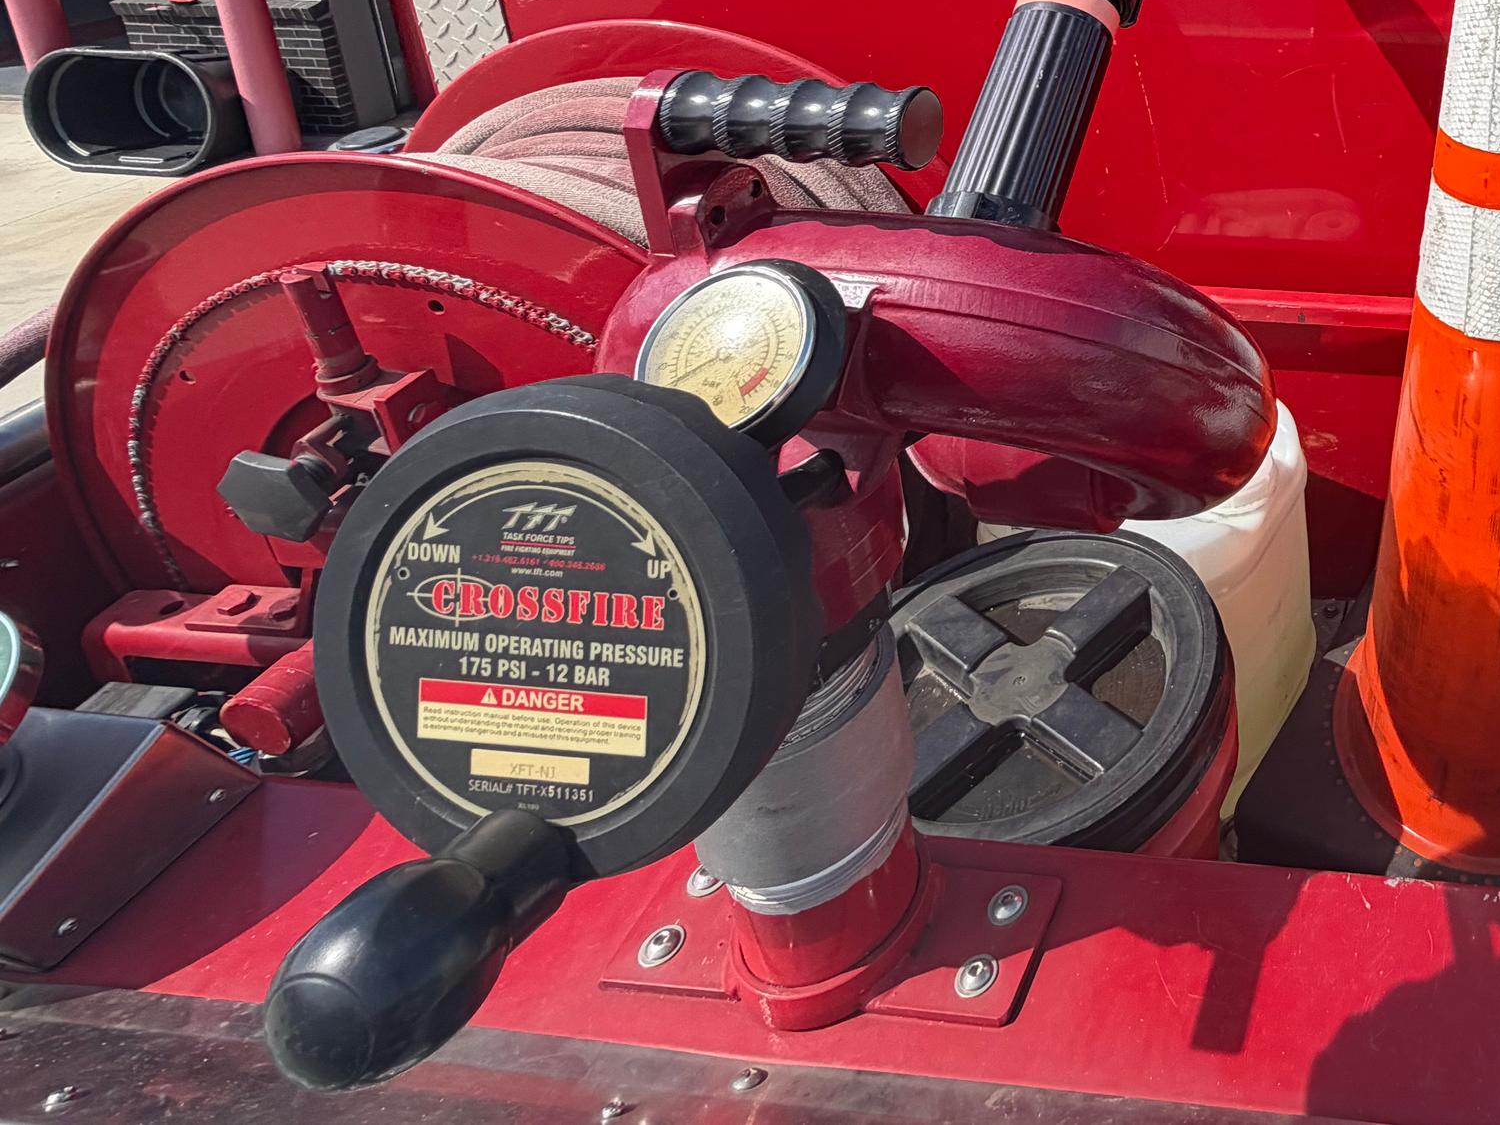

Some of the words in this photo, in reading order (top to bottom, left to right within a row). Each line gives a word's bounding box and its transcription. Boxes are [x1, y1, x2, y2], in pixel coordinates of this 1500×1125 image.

[501, 501, 578, 532] TFT
[502, 531, 524, 541] TASK
[525, 533, 553, 544] FORCE
[555, 535, 575, 545] TIPS
[407, 542, 461, 564] DOWN
[510, 566, 564, 578] www.tft.com
[646, 559, 672, 579] UP
[431, 579, 666, 631] CROSSFIRE
[389, 626, 480, 652] MAXIMUM
[484, 633, 585, 660] OPERATING
[589, 641, 685, 668] PRESSURE
[459, 655, 492, 678] 175
[498, 658, 526, 680] PSI
[545, 663, 569, 684] 12
[573, 665, 611, 687] BAR
[501, 688, 585, 713] DANGER
[423, 706, 442, 715] Read
[444, 708, 481, 718] instruction
[483, 712, 510, 721] manual
[511, 714, 536, 723] before
[554, 717, 591, 728] Operation
[592, 720, 600, 728] of
[602, 721, 616, 729] this
[617, 722, 642, 732] device
[423, 715, 449, 723] without
[450, 717, 501, 729] understanding
[501, 721, 513, 729] the
[514, 723, 540, 731] manual
[555, 727, 588, 737] receiving
[588, 729, 613, 739] proper
[613, 730, 642, 741] training
[464, 726, 502, 736] dangerous
[556, 734, 570, 742] this
[468, 779, 513, 794] SERIAL#
[515, 783, 594, 803] TFT-X511351
